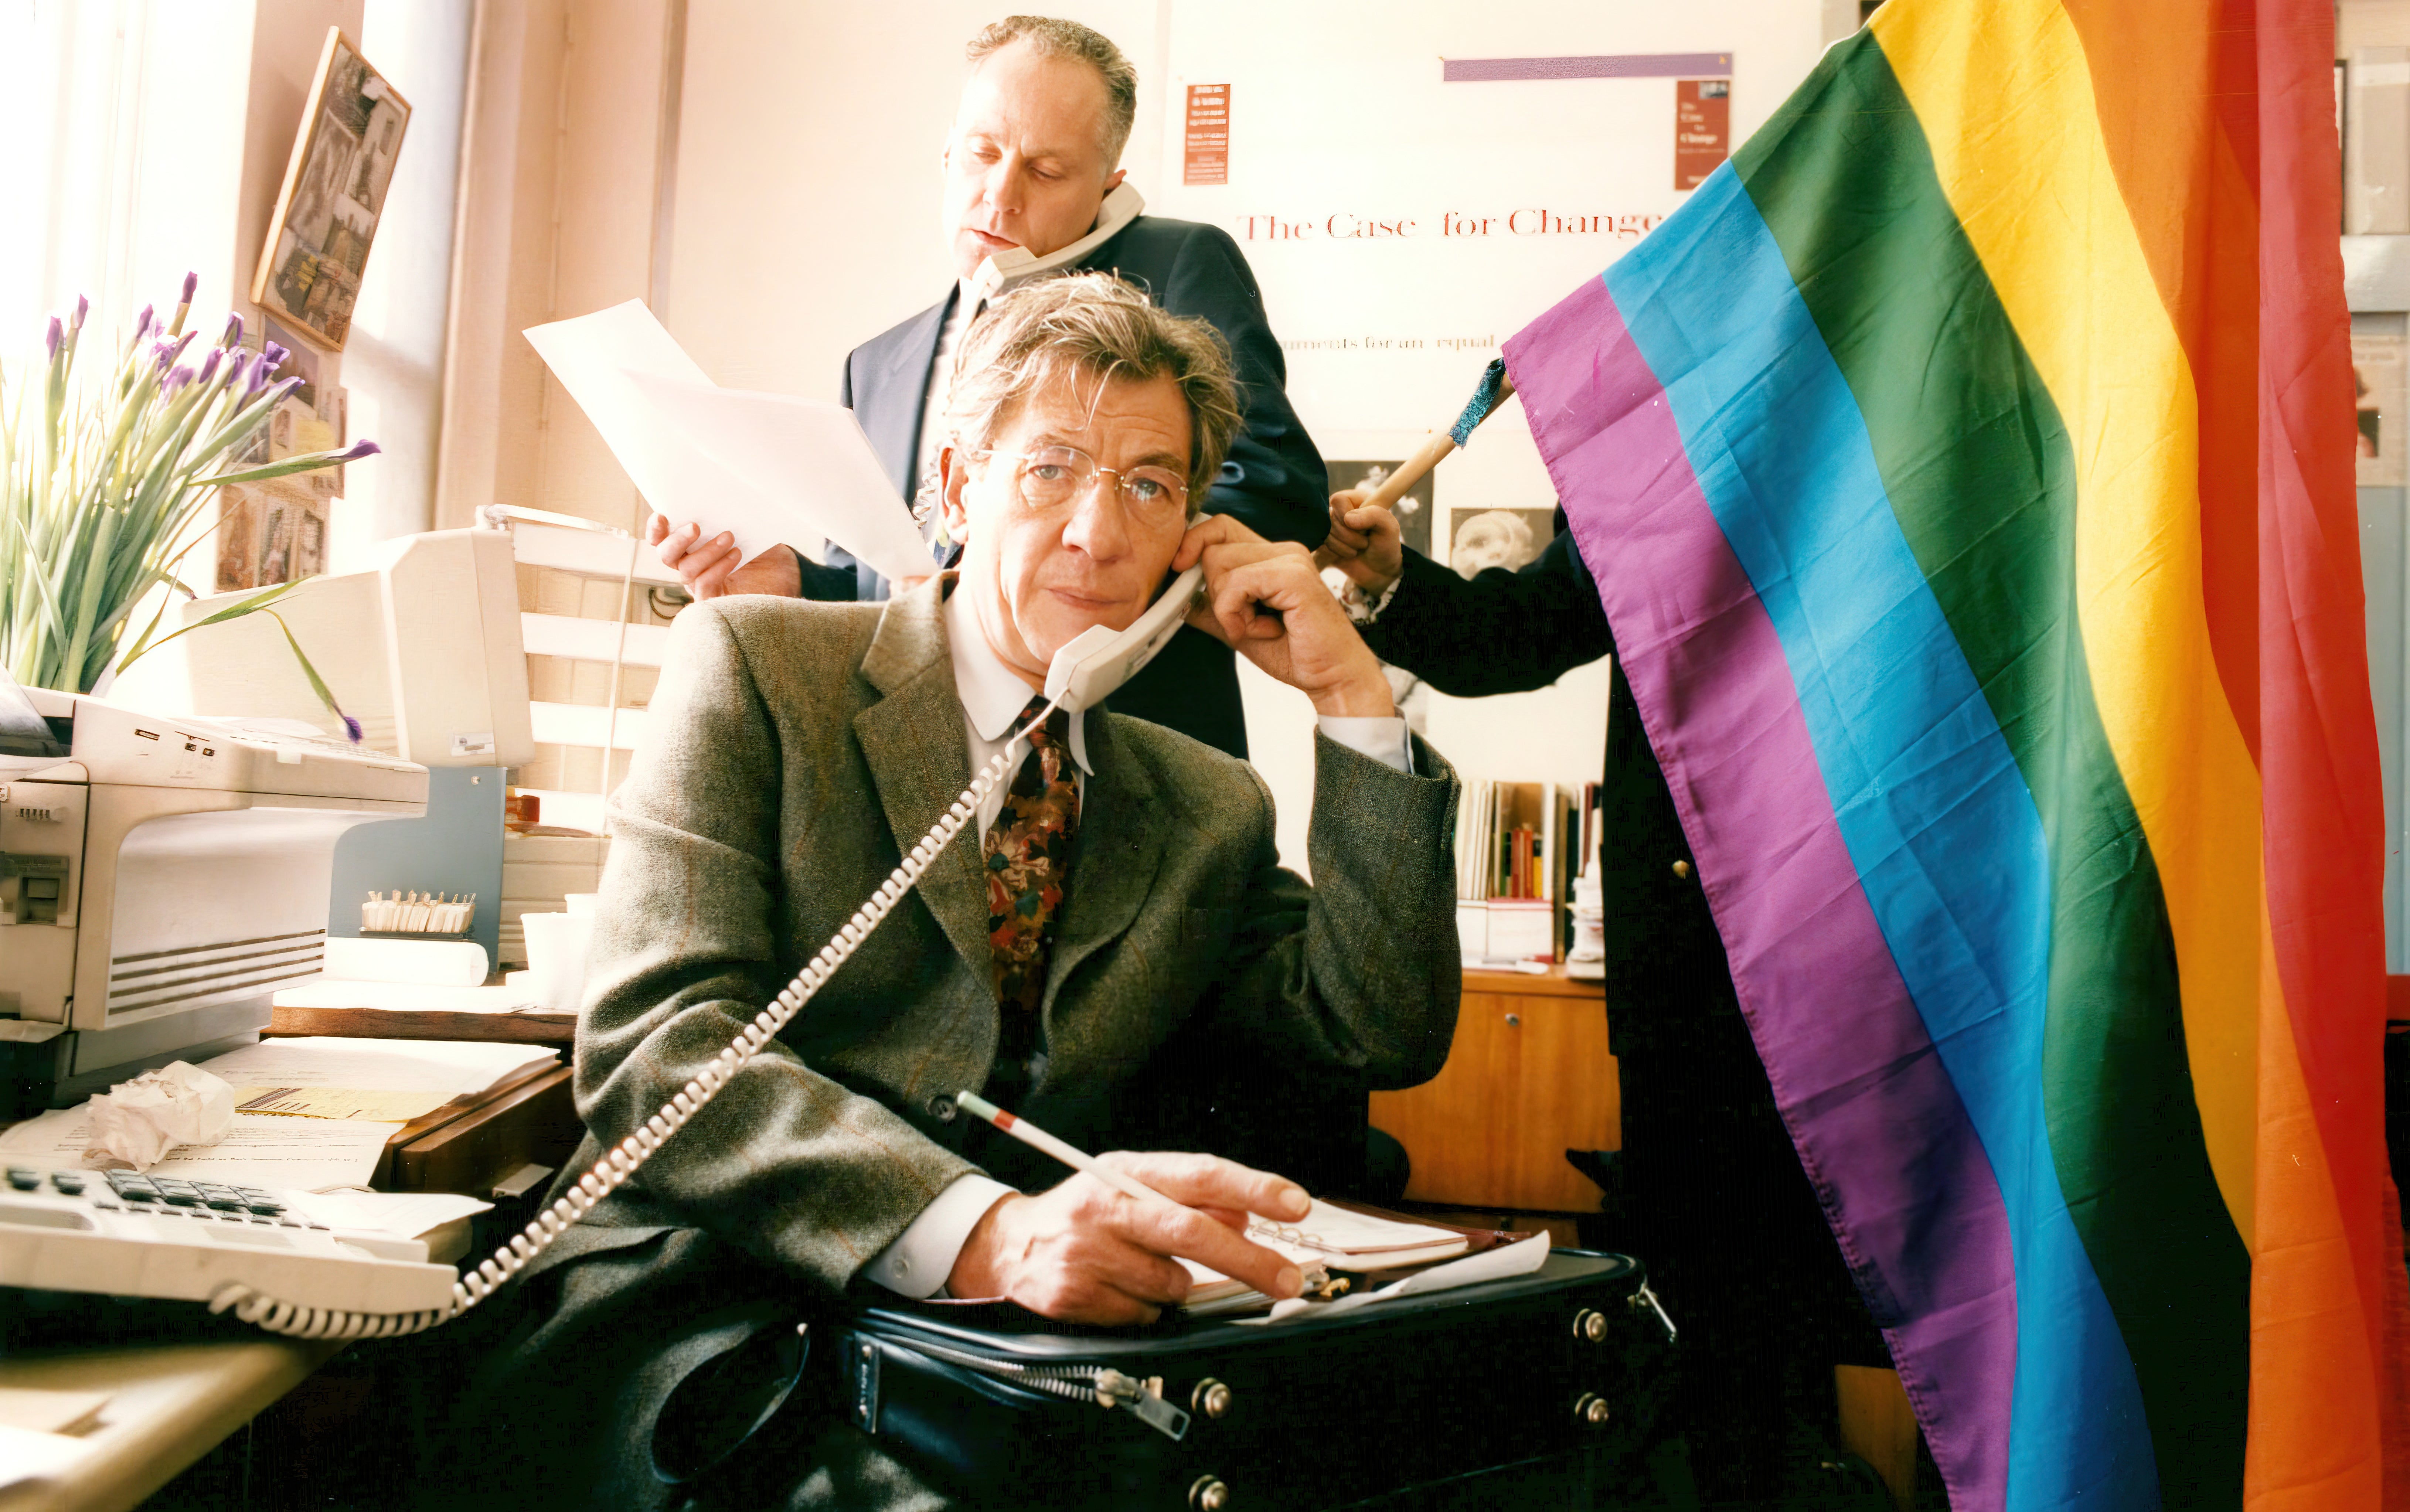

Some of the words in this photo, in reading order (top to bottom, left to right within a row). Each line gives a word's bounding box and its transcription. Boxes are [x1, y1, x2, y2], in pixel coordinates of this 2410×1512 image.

[1236, 214, 1313, 240] The
[1325, 212, 1417, 238] Case
[1442, 211, 1498, 236] for
[1509, 209, 1663, 239] Change
